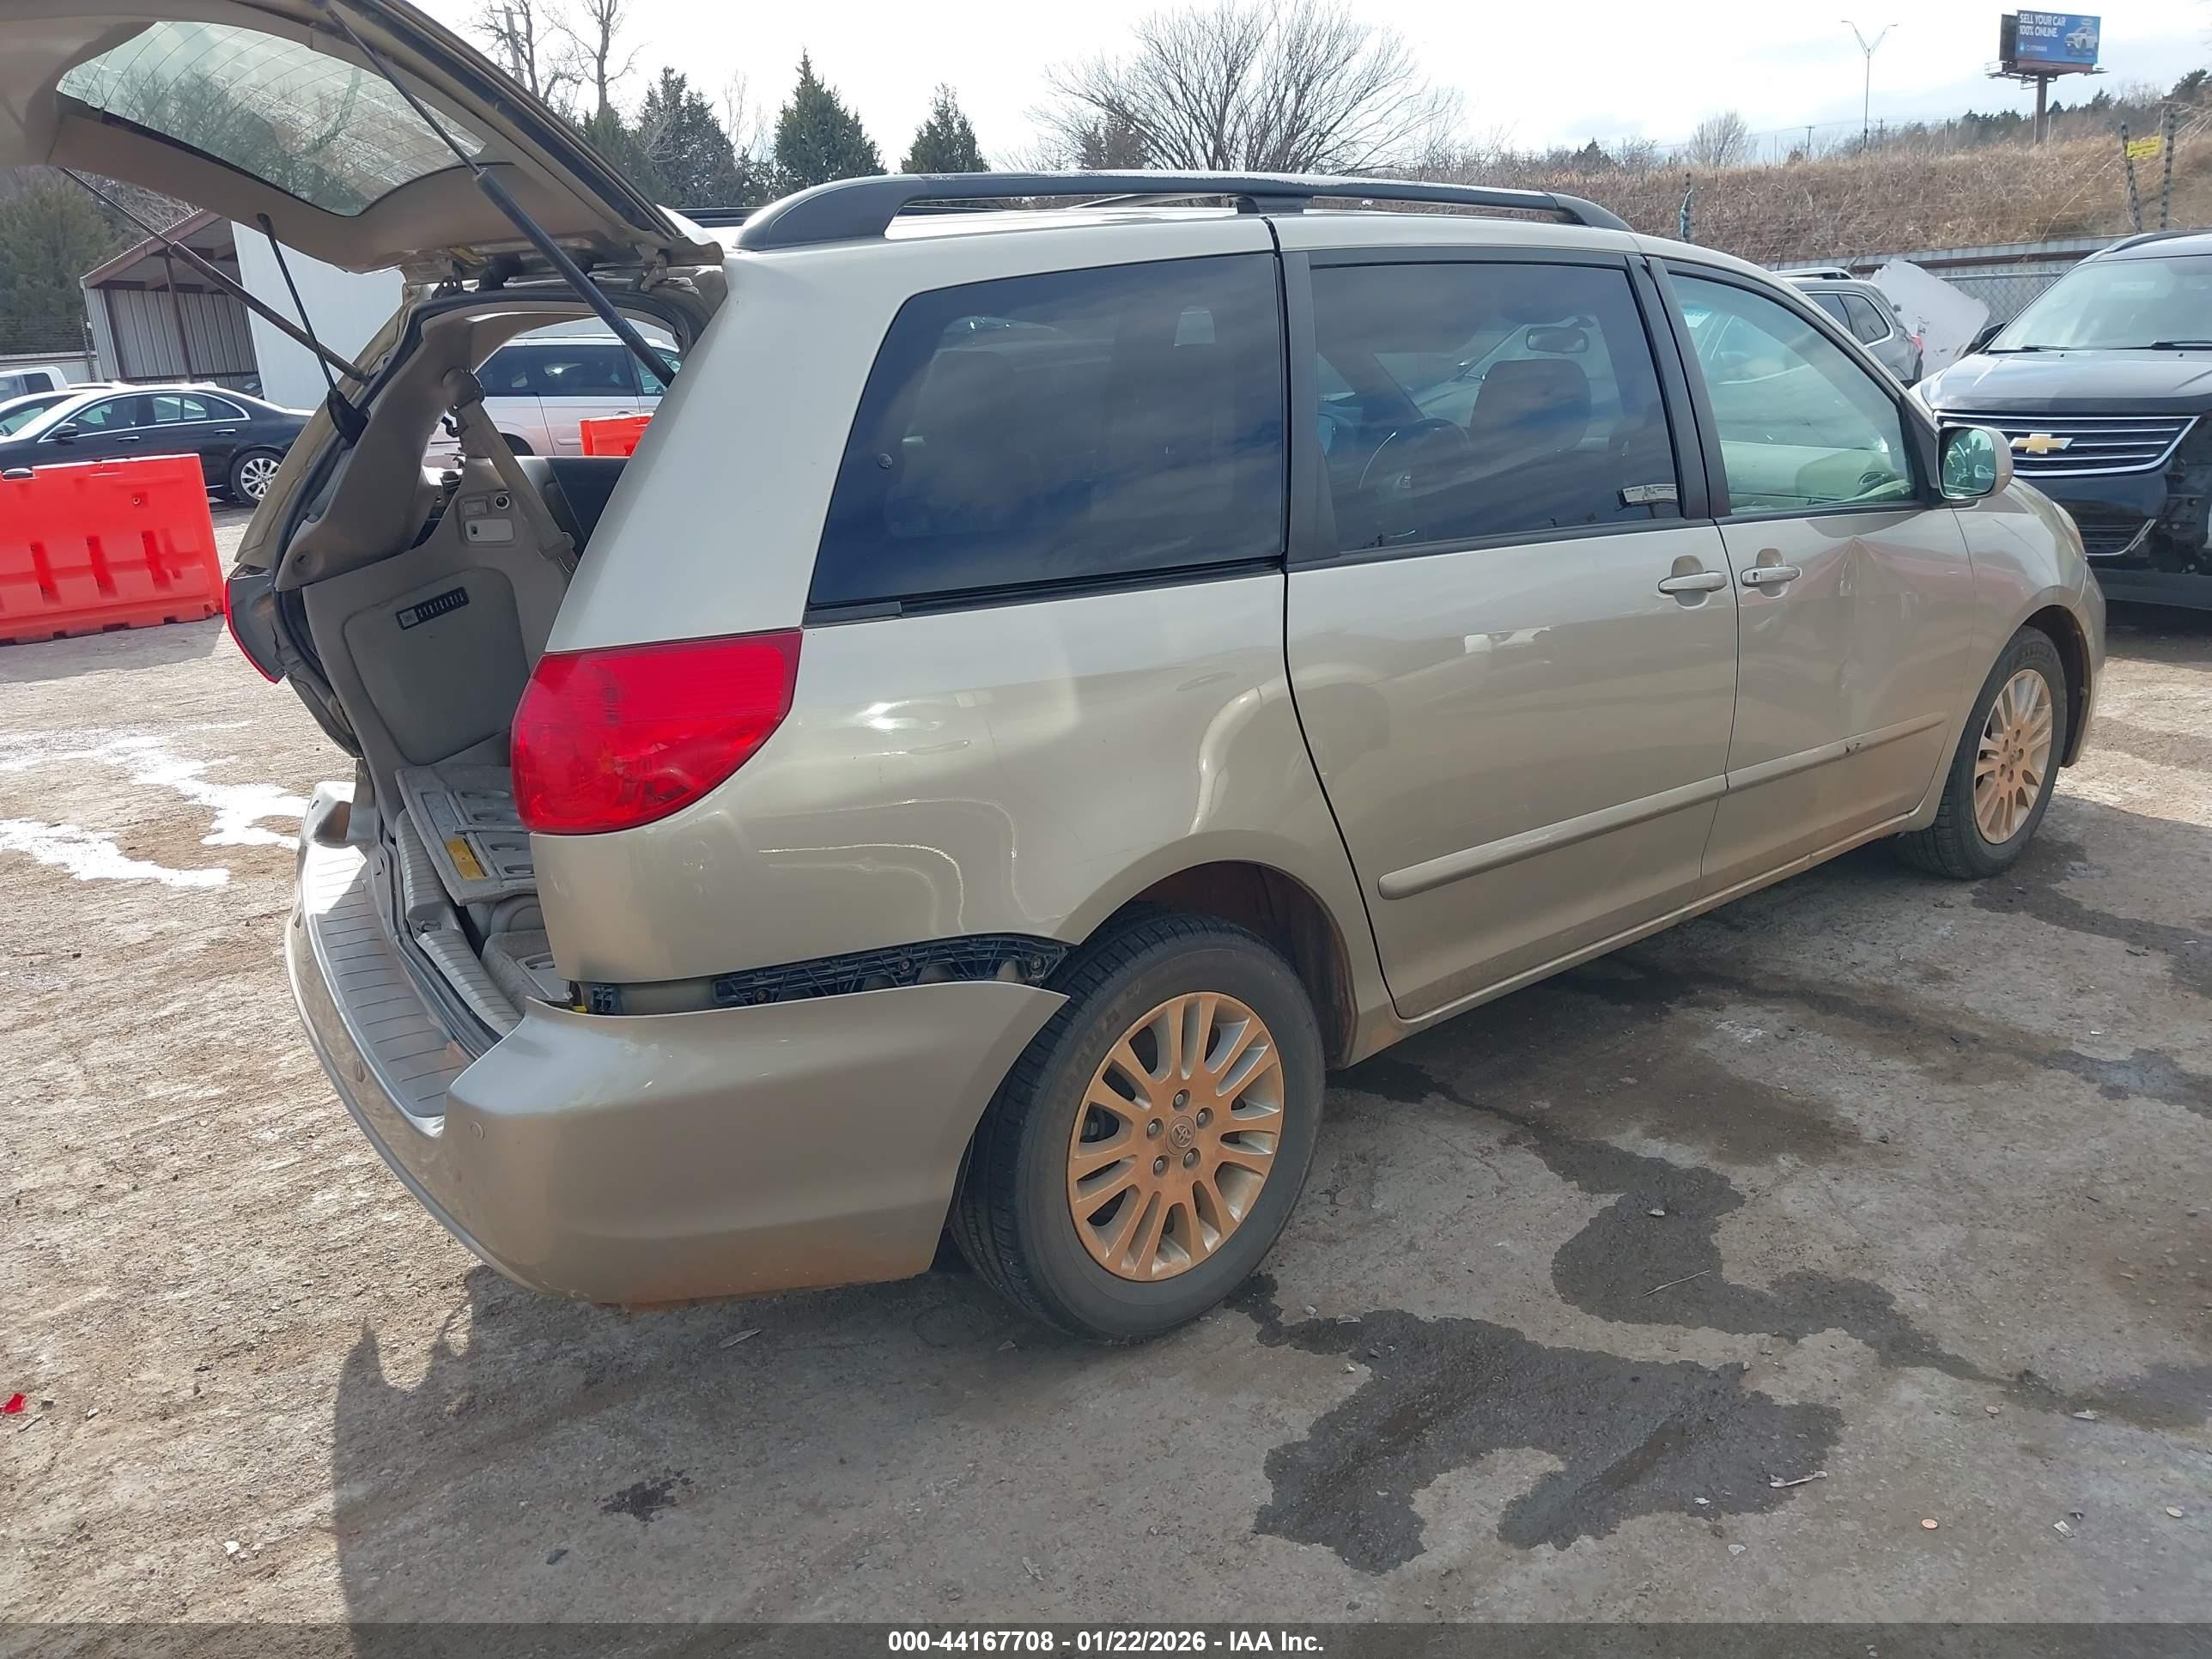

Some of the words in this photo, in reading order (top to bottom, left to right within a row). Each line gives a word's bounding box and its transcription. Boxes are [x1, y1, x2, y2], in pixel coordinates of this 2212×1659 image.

[2020, 14, 2033, 24] SELL
[2034, 15, 2052, 26] YOUR
[2053, 16, 2066, 27] CAR
[2020, 25, 2033, 35] 100%
